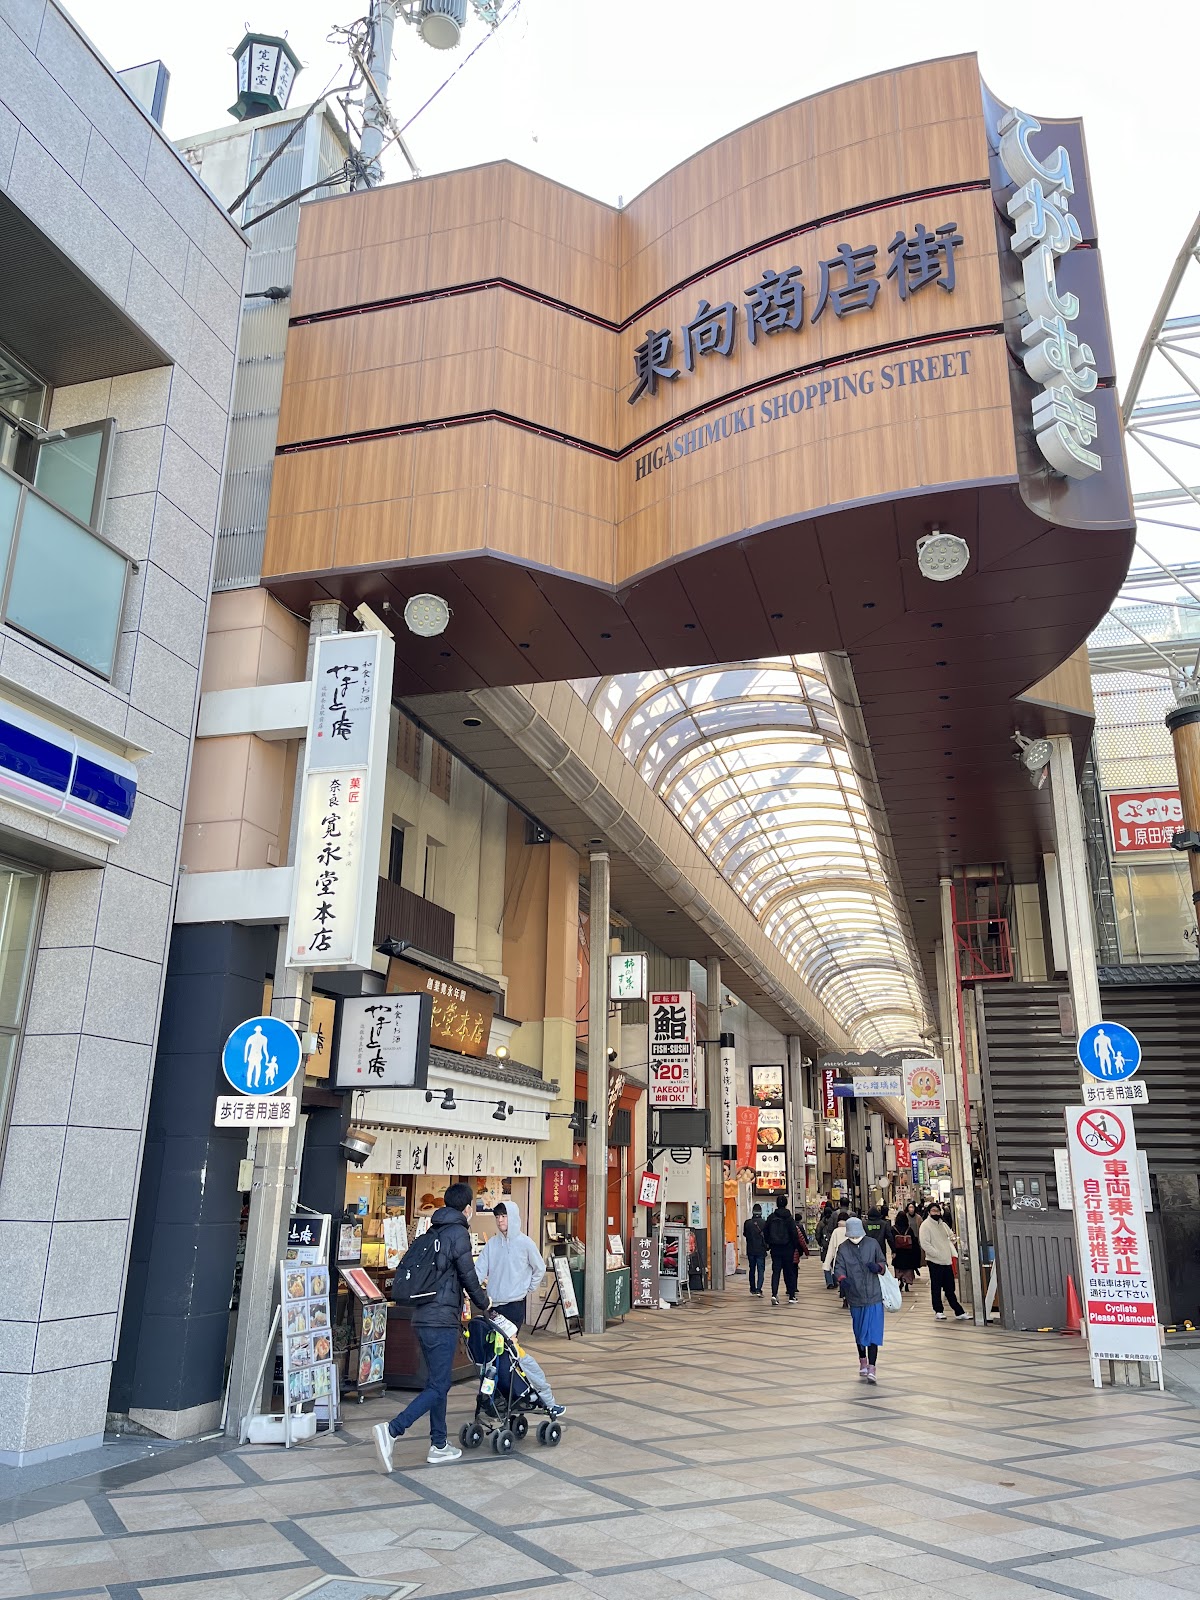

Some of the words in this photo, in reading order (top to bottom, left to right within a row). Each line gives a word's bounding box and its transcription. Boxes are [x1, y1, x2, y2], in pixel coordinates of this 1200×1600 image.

[997, 107, 1102, 480] ひがしむき
[627, 221, 964, 405] 東向商店街
[634, 403, 756, 482] HIGASHIMUKI
[760, 369, 876, 424] SHOPPING
[880, 350, 972, 391] STREET
[326, 664, 359, 741] やまと庵
[653, 1005, 687, 1042] 鮨
[364, 1004, 392, 1079] やまと庵
[1087, 1085, 1143, 1102] 歩行者用道路
[220, 1102, 291, 1120] 歩行者用道路
[1083, 1178, 1110, 1274] 自行車請推行
[1103, 1158, 1142, 1275] 車両乗入禁止
[638, 1238, 652, 1270] 柿の葉
[640, 1278, 653, 1299] 茶屋
[1089, 1278, 1148, 1288] 自転車は押して
[1090, 1288, 1150, 1299] 通行して下さい
[1089, 1313, 1116, 1322] Please
[1117, 1314, 1156, 1323] Dismount
[1105, 1303, 1138, 1314] Cyclists
